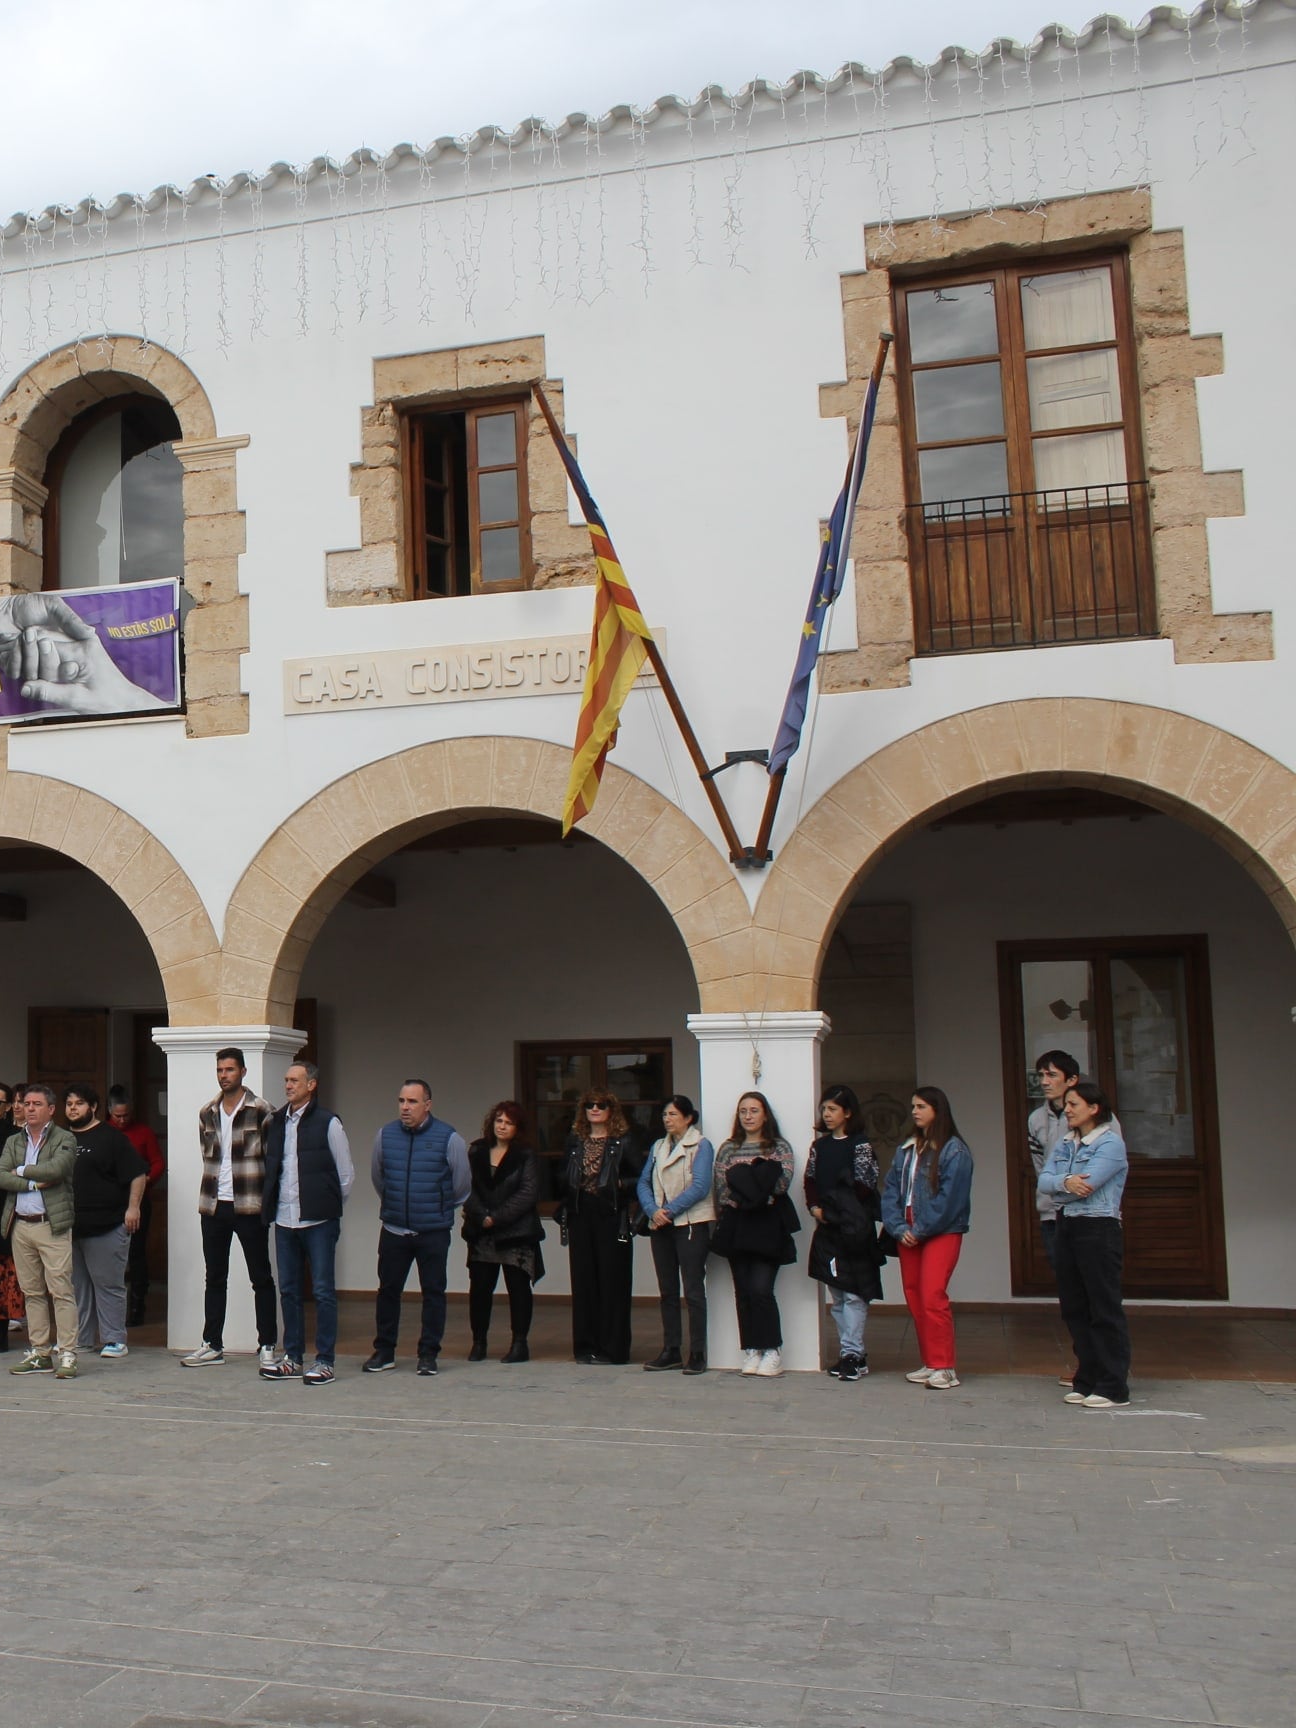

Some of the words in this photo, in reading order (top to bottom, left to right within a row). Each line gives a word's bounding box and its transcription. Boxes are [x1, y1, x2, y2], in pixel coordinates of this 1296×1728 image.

[107, 626, 122, 638] NO
[150, 614, 176, 632] SOLA
[292, 660, 384, 704] CASA
